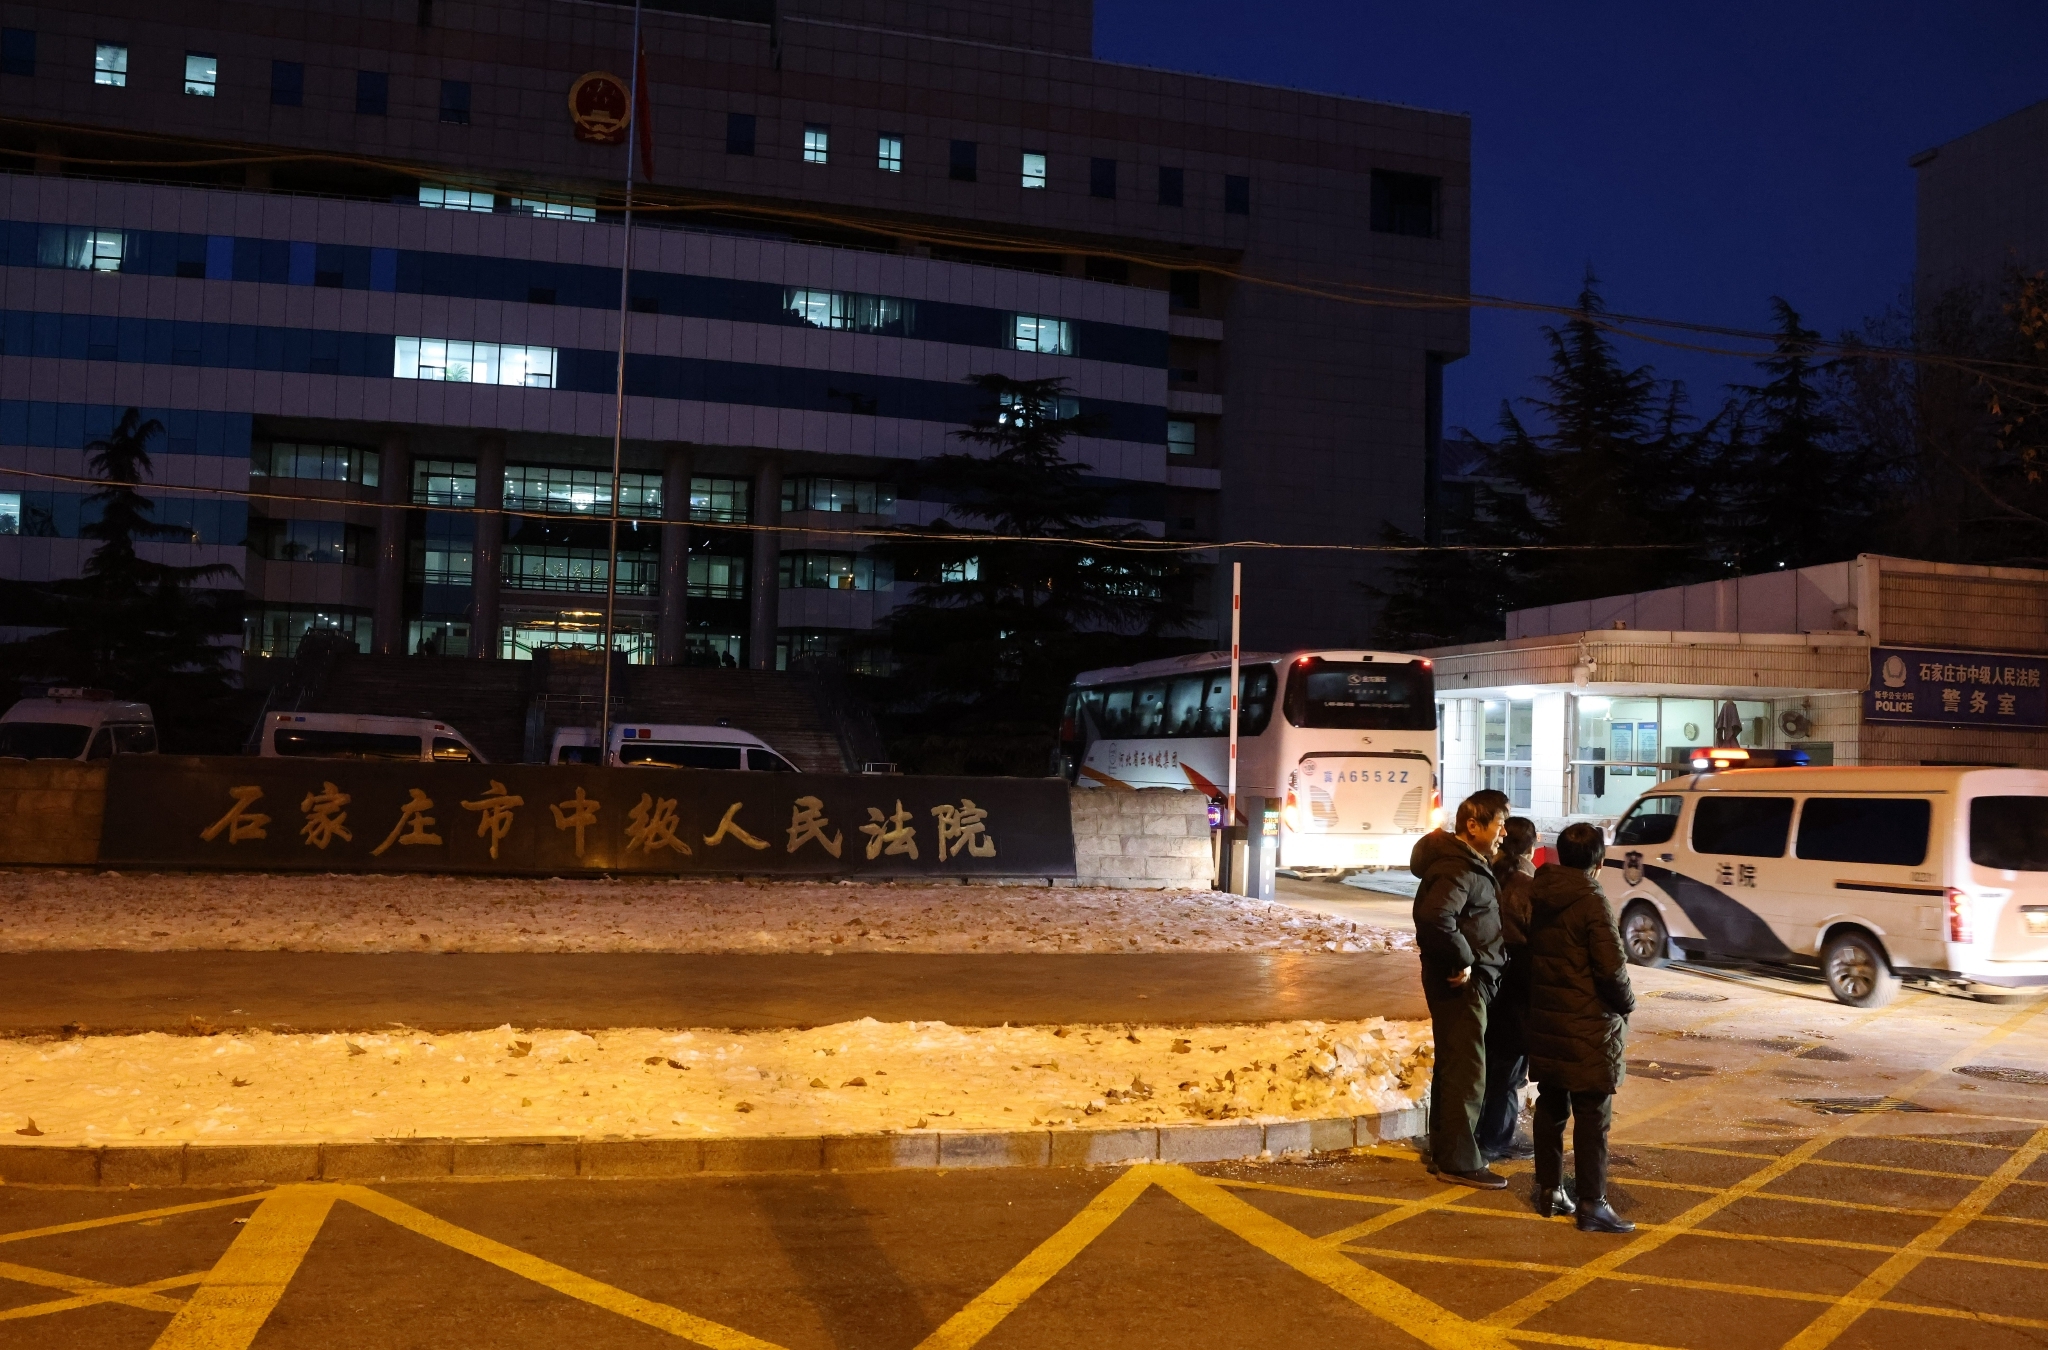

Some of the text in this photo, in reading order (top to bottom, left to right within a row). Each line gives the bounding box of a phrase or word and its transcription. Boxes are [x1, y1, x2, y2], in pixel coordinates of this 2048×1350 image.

[1919, 662, 2041, 688] 石家庄市中级人民法院
[1874, 691, 1915, 701] 新华公安分局
[1875, 701, 1913, 713] POLICE
[1941, 688, 2016, 716] 警务室
[203, 780, 997, 861] 石家庄市中级人民法院
[1715, 862, 1757, 888] 法院
